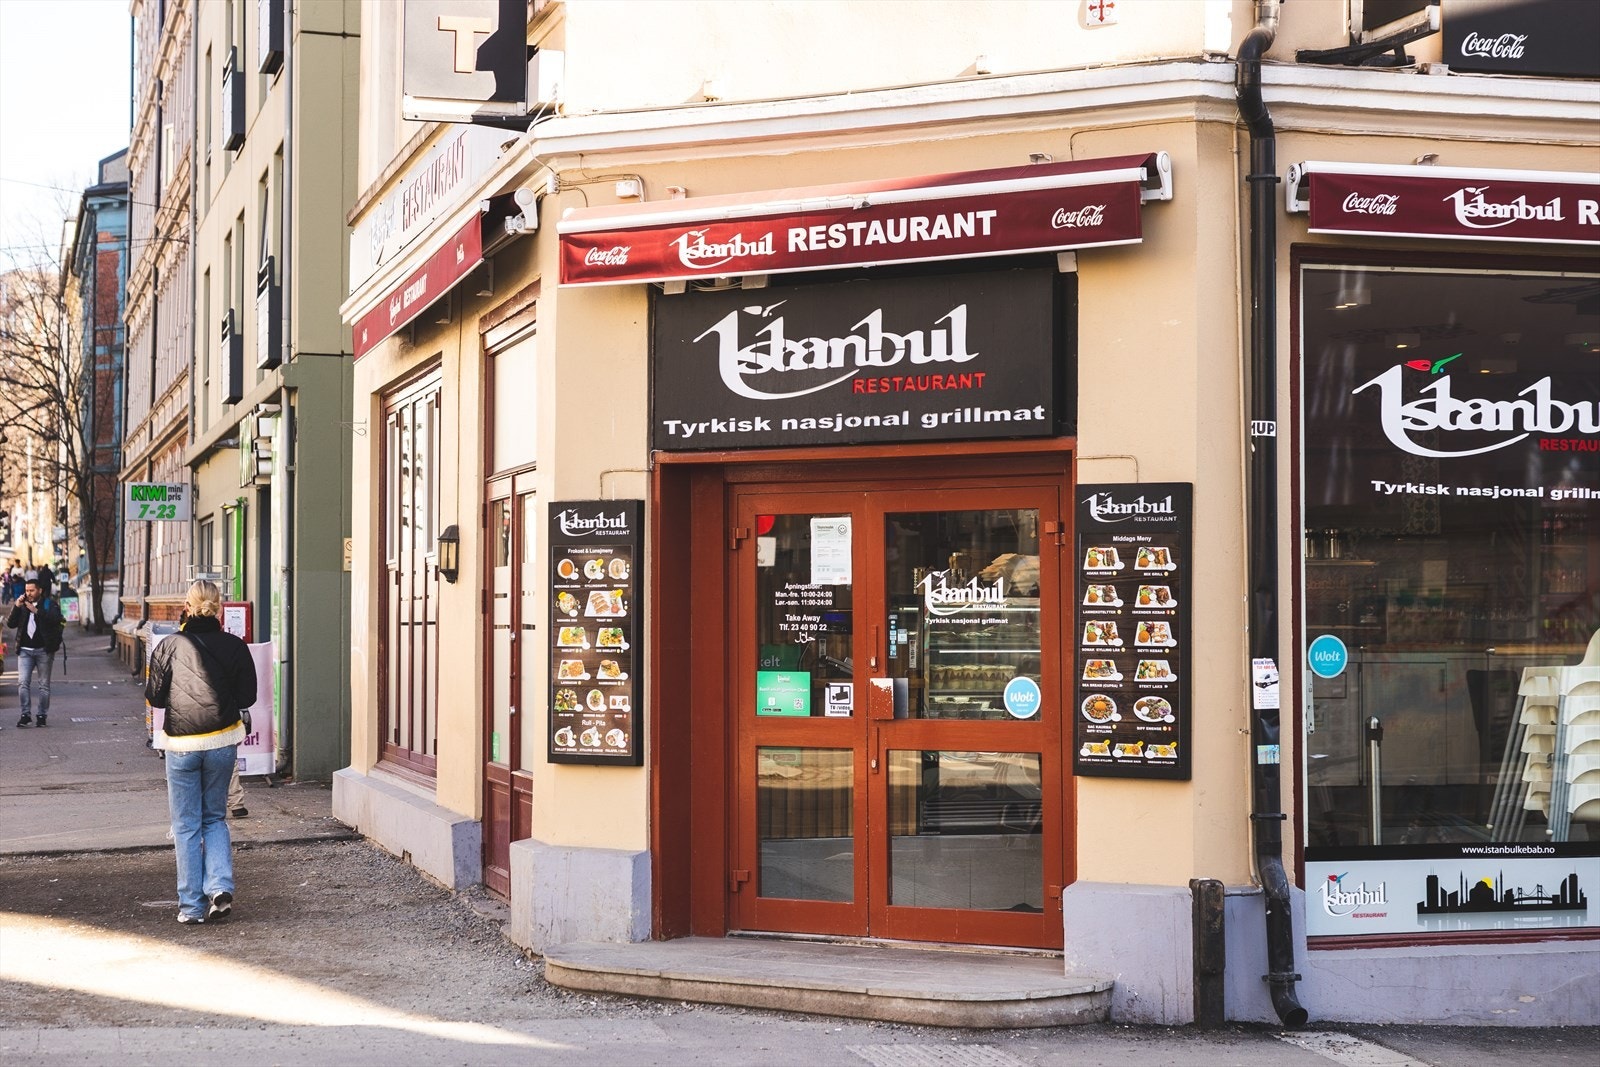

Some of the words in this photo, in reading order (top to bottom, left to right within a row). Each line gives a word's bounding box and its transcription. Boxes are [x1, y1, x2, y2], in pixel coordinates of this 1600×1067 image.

[1461, 32, 1528, 59] Coca-Cola
[1342, 192, 1399, 216] Coca-Cola
[1443, 187, 1566, 229] Istanbul
[584, 245, 632, 267] Coca-Cola
[669, 229, 776, 270] Istanbul
[788, 209, 997, 252] RESTAURANT
[1051, 204, 1107, 230] Coca-Cola
[694, 303, 980, 400] Istanbul
[852, 372, 986, 394] RESTAURANT
[663, 416, 772, 439] Tyrkisk
[782, 408, 910, 433] nasjonal
[920, 405, 1046, 430] grillmat
[131, 485, 167, 501] KIWI
[168, 493, 181, 501] pris
[1371, 480, 1450, 495] Tyrkisk
[1456, 485, 1544, 499] nasjonal
[138, 504, 176, 519] 7-23
[1081, 493, 1175, 523] Istanbul
[554, 511, 628, 536] Istanbul
[916, 573, 1008, 616] Istanbul
[779, 623, 790, 631] Tlf.
[790, 623, 799, 631] 23
[800, 623, 809, 631] 40
[809, 623, 818, 631] 90
[818, 623, 828, 631] 22
[802, 614, 821, 623] Away
[1315, 651, 1341, 662] Wolt
[1010, 692, 1035, 703] Wolt
[1461, 845, 1555, 855] www.istanbulkebab.no
[1316, 880, 1389, 917] Istanbul
